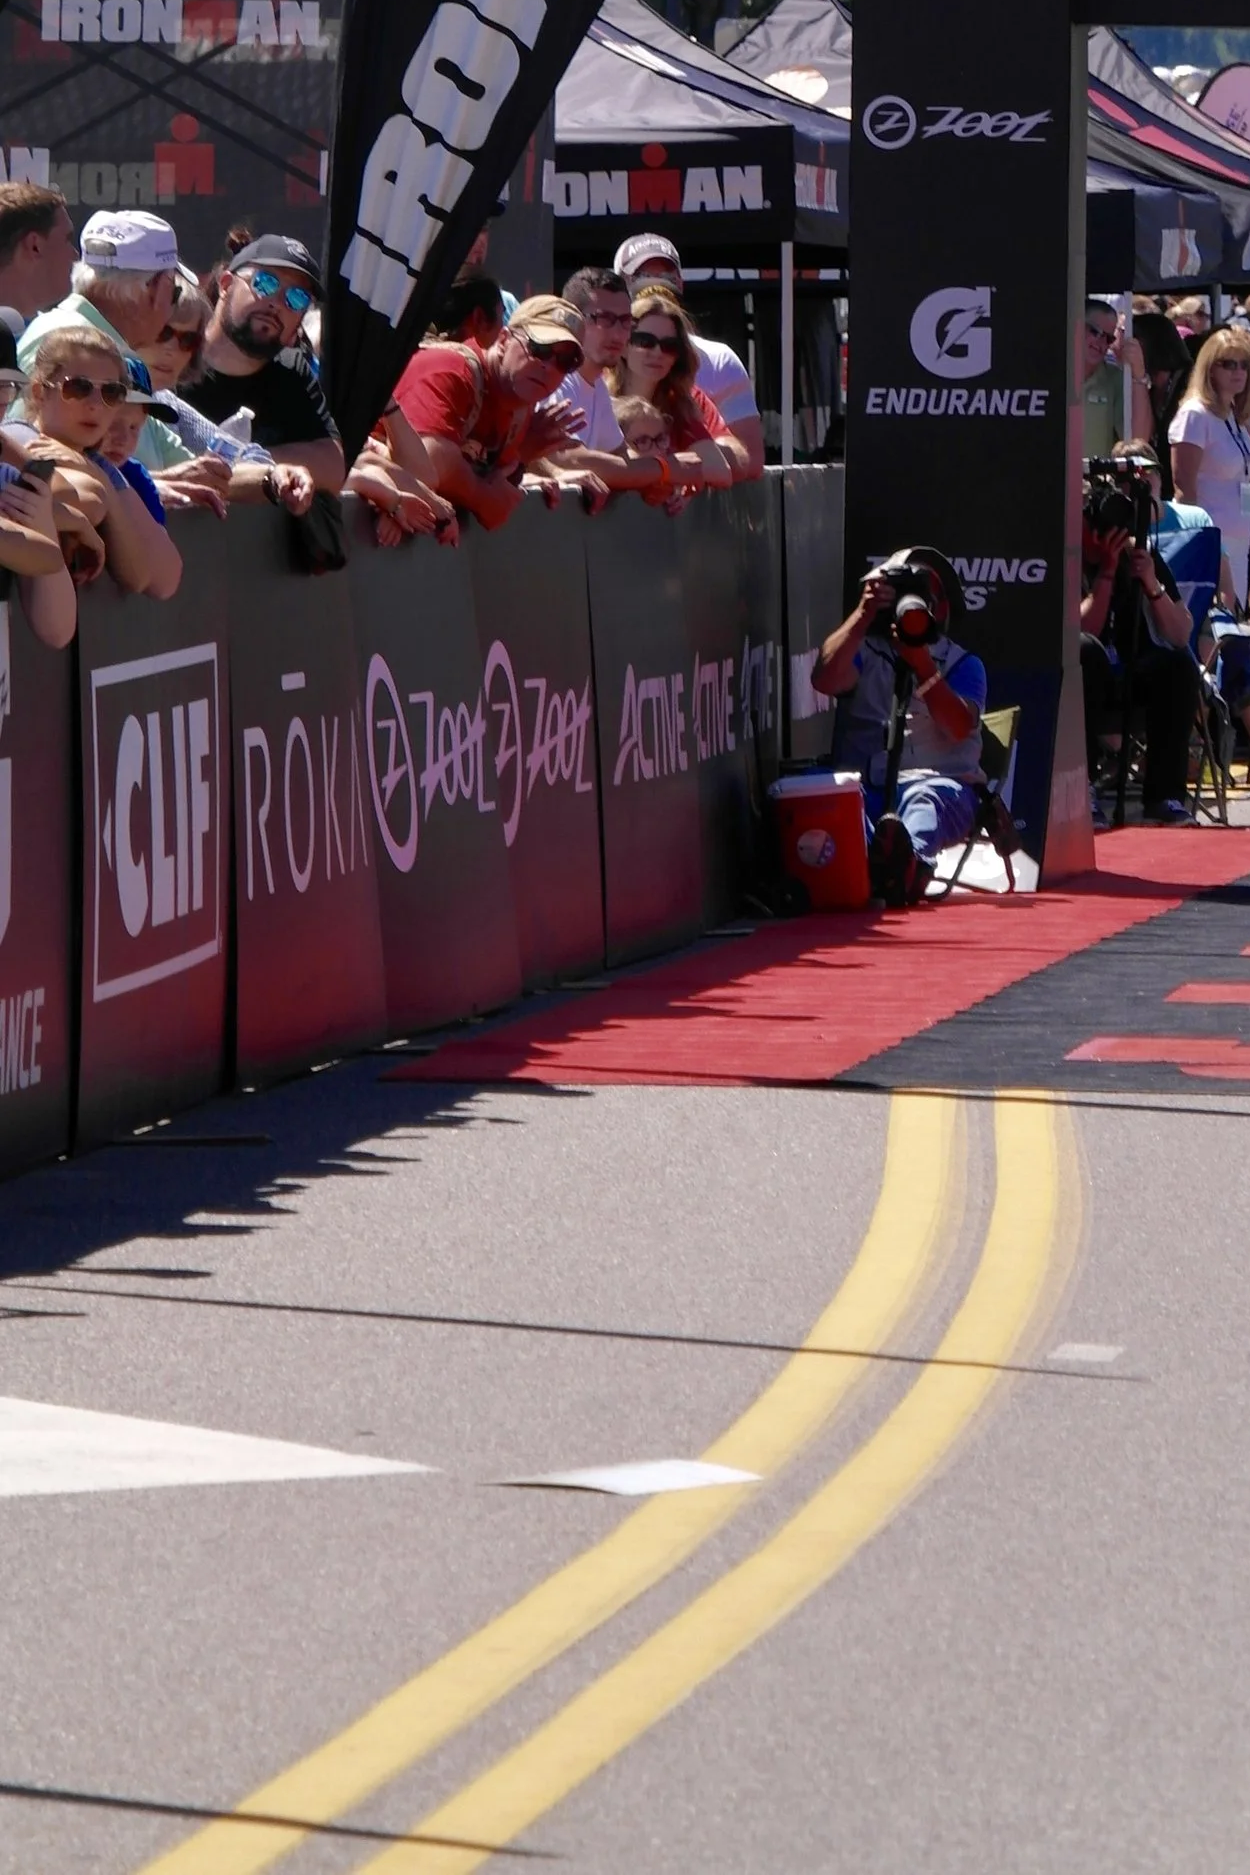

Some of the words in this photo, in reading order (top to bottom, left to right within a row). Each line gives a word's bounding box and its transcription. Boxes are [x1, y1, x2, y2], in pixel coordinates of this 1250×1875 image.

[553, 142, 764, 217] ONMAN
[865, 387, 1050, 416] ENDURANCE
[866, 556, 1048, 583] TNING
[614, 663, 688, 786] ACTIVE
[115, 698, 209, 938] CLIF
